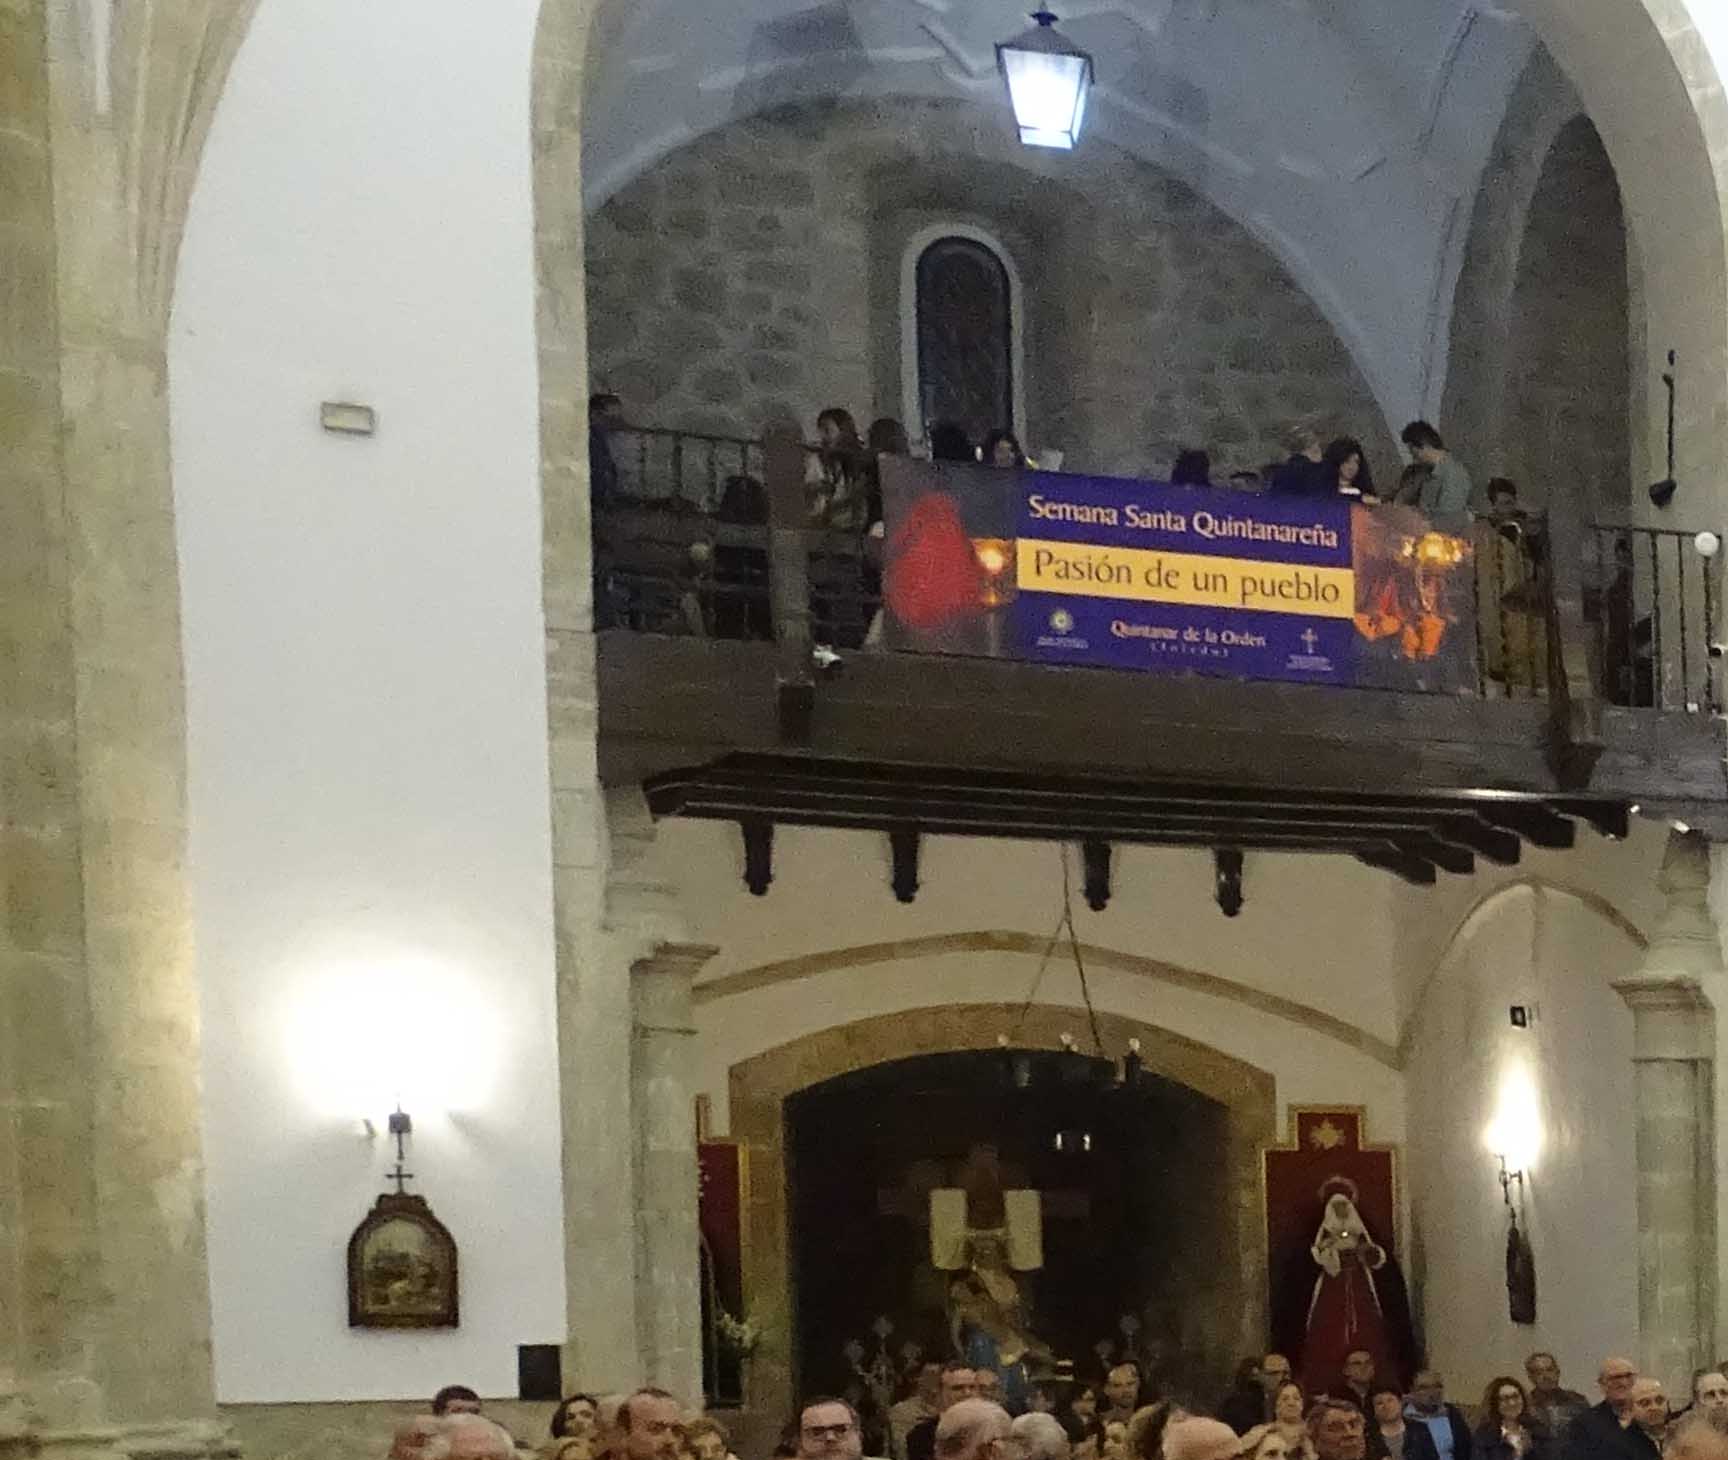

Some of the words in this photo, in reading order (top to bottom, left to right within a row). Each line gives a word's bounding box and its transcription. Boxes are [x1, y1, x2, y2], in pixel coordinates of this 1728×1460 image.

[1029, 495, 1118, 526] Semana
[1125, 504, 1186, 532] Santa
[1192, 511, 1338, 547] Quintanareña
[1036, 549, 1132, 584] Pasión
[1144, 559, 1180, 589] de
[1193, 571, 1227, 593] un
[1241, 571, 1340, 605] pueblo
[1183, 626, 1201, 642] de
[1205, 627, 1219, 643] la
[1220, 630, 1266, 647] Orden
